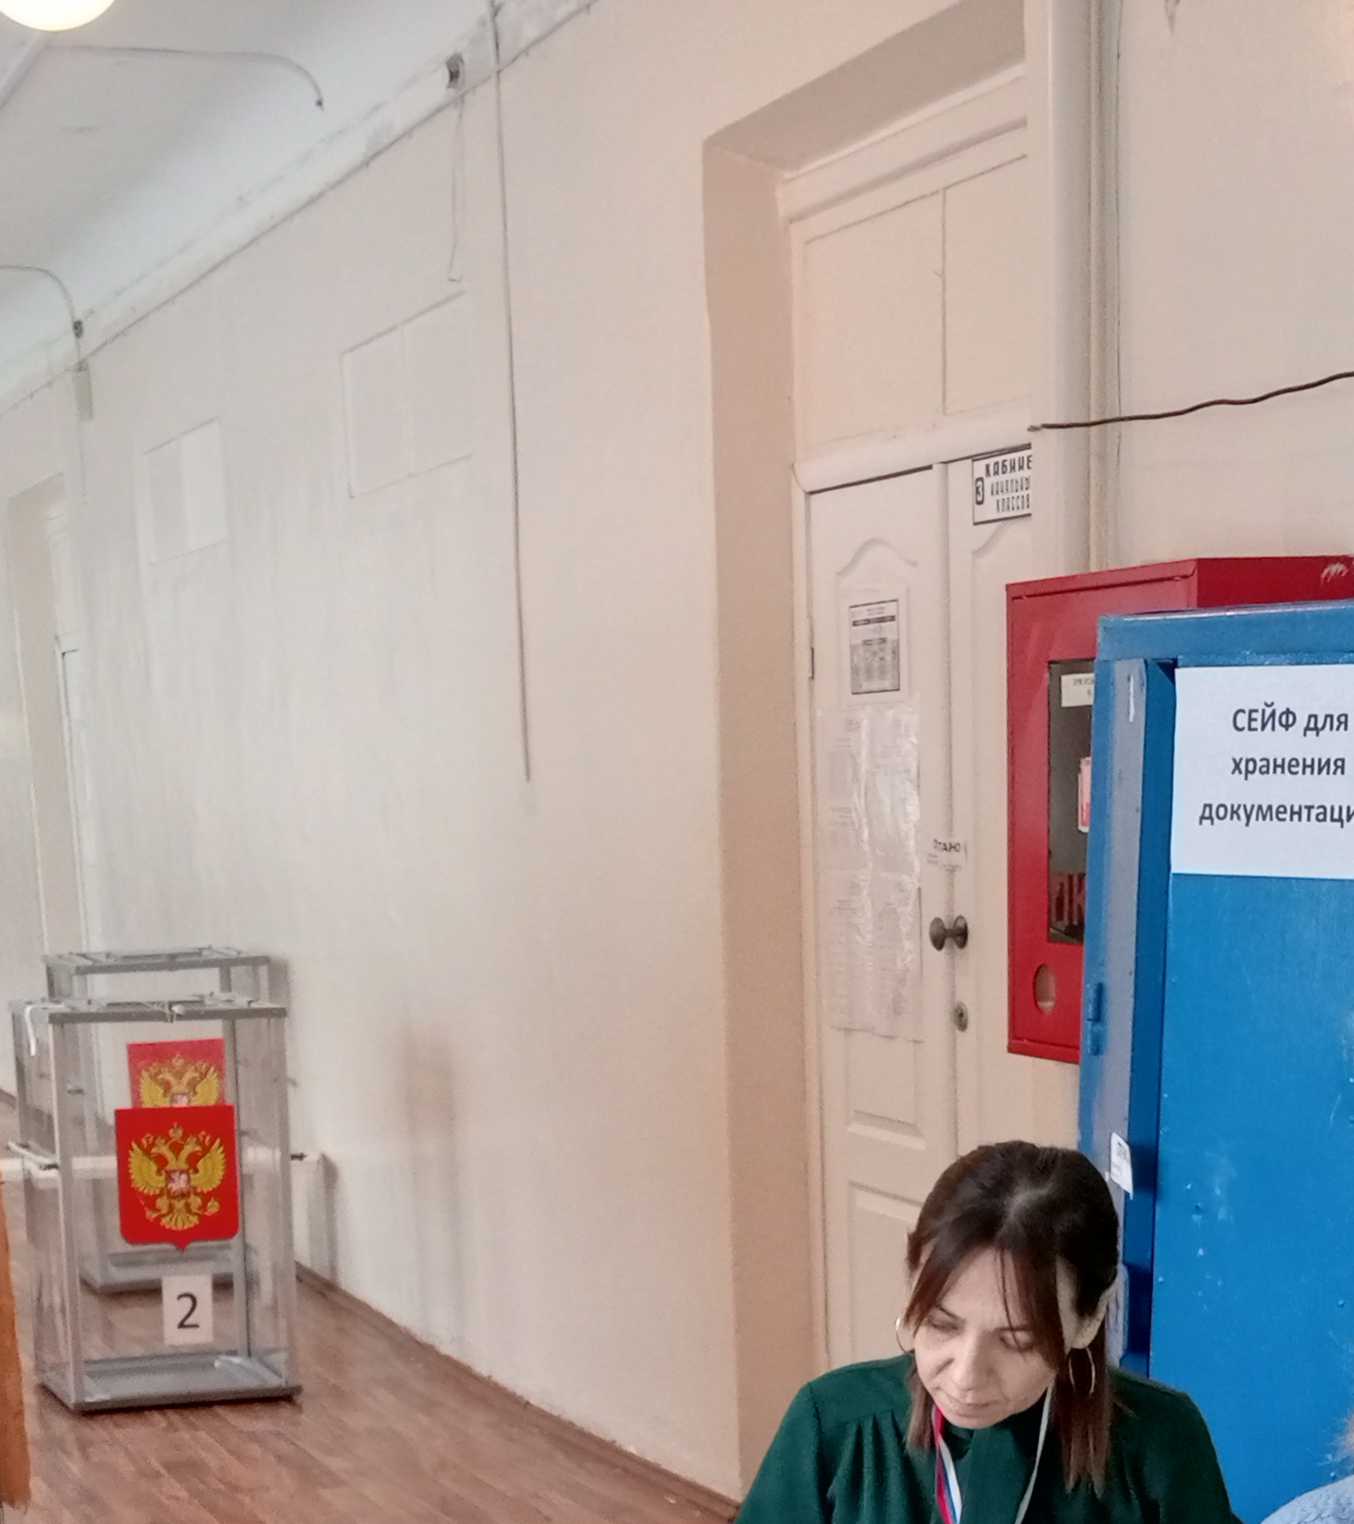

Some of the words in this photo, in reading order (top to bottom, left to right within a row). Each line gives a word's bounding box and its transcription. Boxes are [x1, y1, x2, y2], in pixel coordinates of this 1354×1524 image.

[1232, 701, 1297, 732] СЕЙФ
[1303, 713, 1349, 738] для
[1231, 756, 1346, 781] хранения
[176, 1292, 200, 1330] 2
